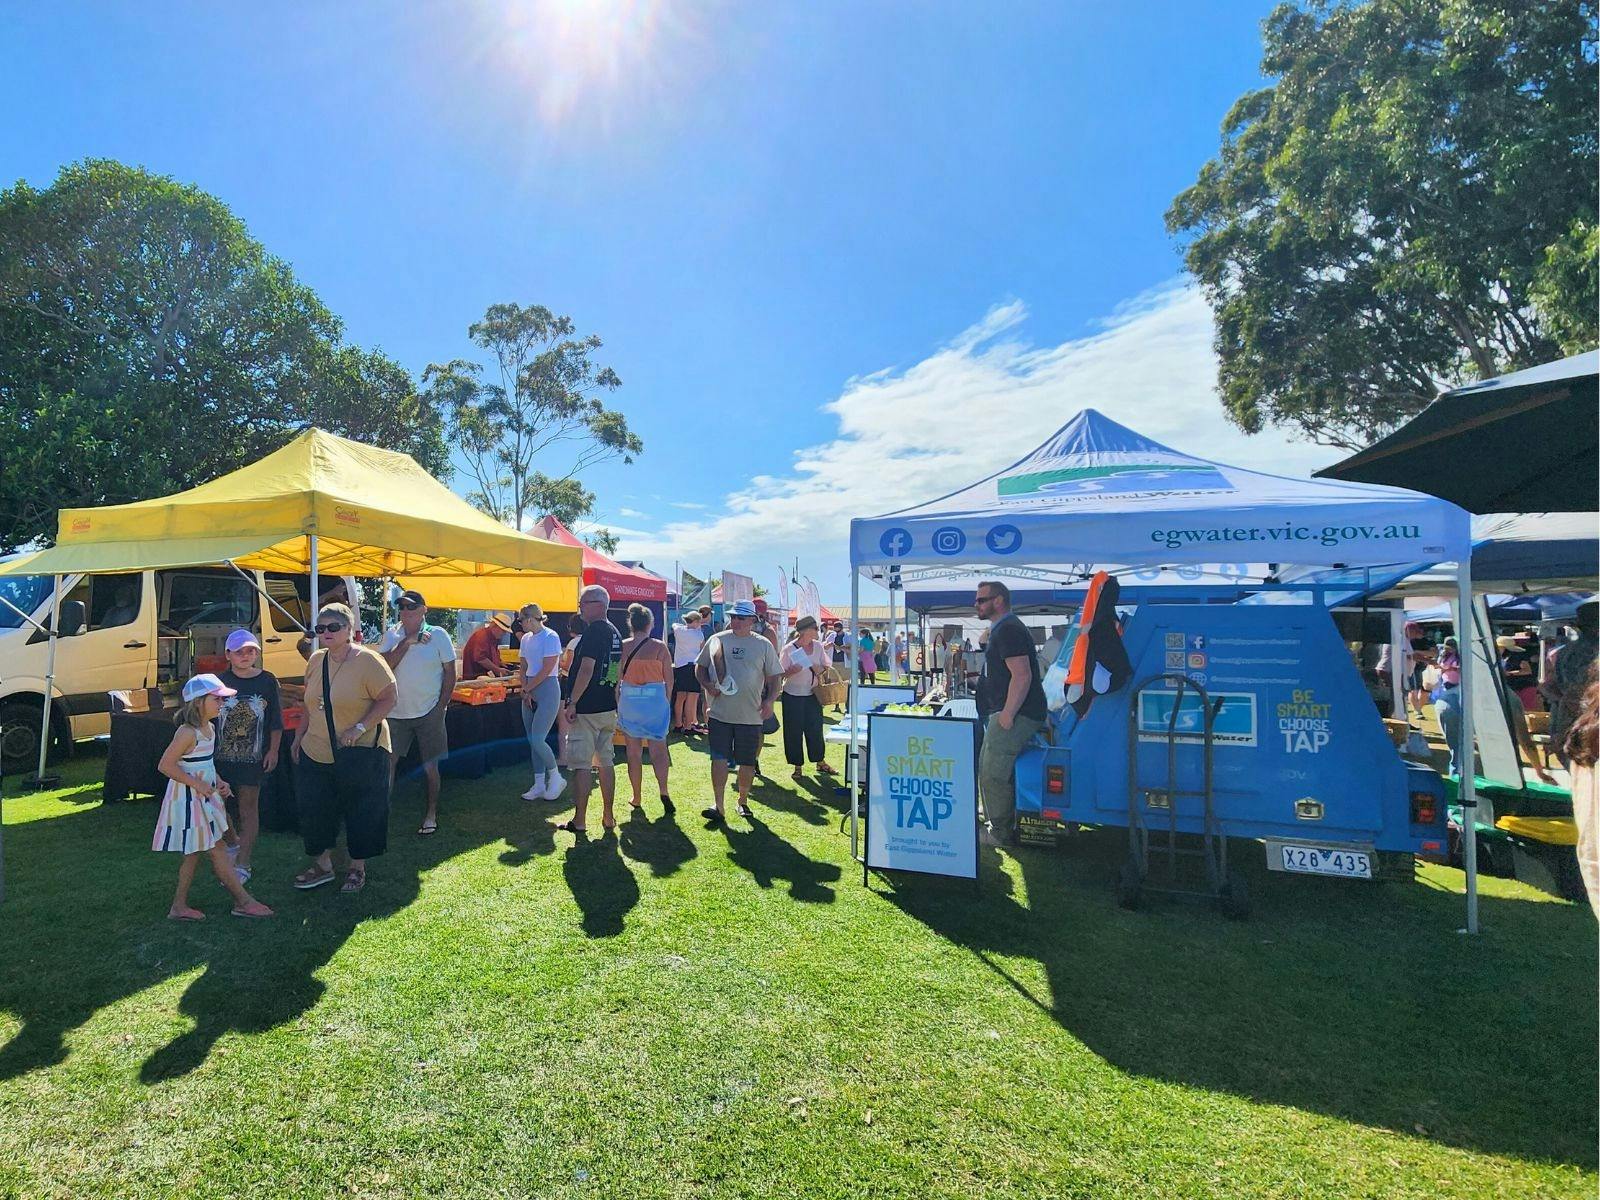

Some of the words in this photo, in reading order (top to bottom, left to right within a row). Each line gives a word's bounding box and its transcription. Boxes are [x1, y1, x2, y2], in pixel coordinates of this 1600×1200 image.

[1151, 522, 1421, 549] egwater.vic.gov.au
[1292, 689, 1315, 704] BE
[1276, 703, 1331, 719] SMART
[1278, 718, 1330, 732] CHOOSE
[907, 736, 934, 756] BE
[1212, 734, 1253, 742] Water
[1280, 730, 1330, 754] TAP
[886, 755, 955, 780] SMART
[889, 777, 954, 798] CHOOSE
[890, 794, 953, 831] TAP
[885, 843, 900, 852] East
[1285, 848, 1319, 868] X28
[1333, 854, 1367, 873] 435
